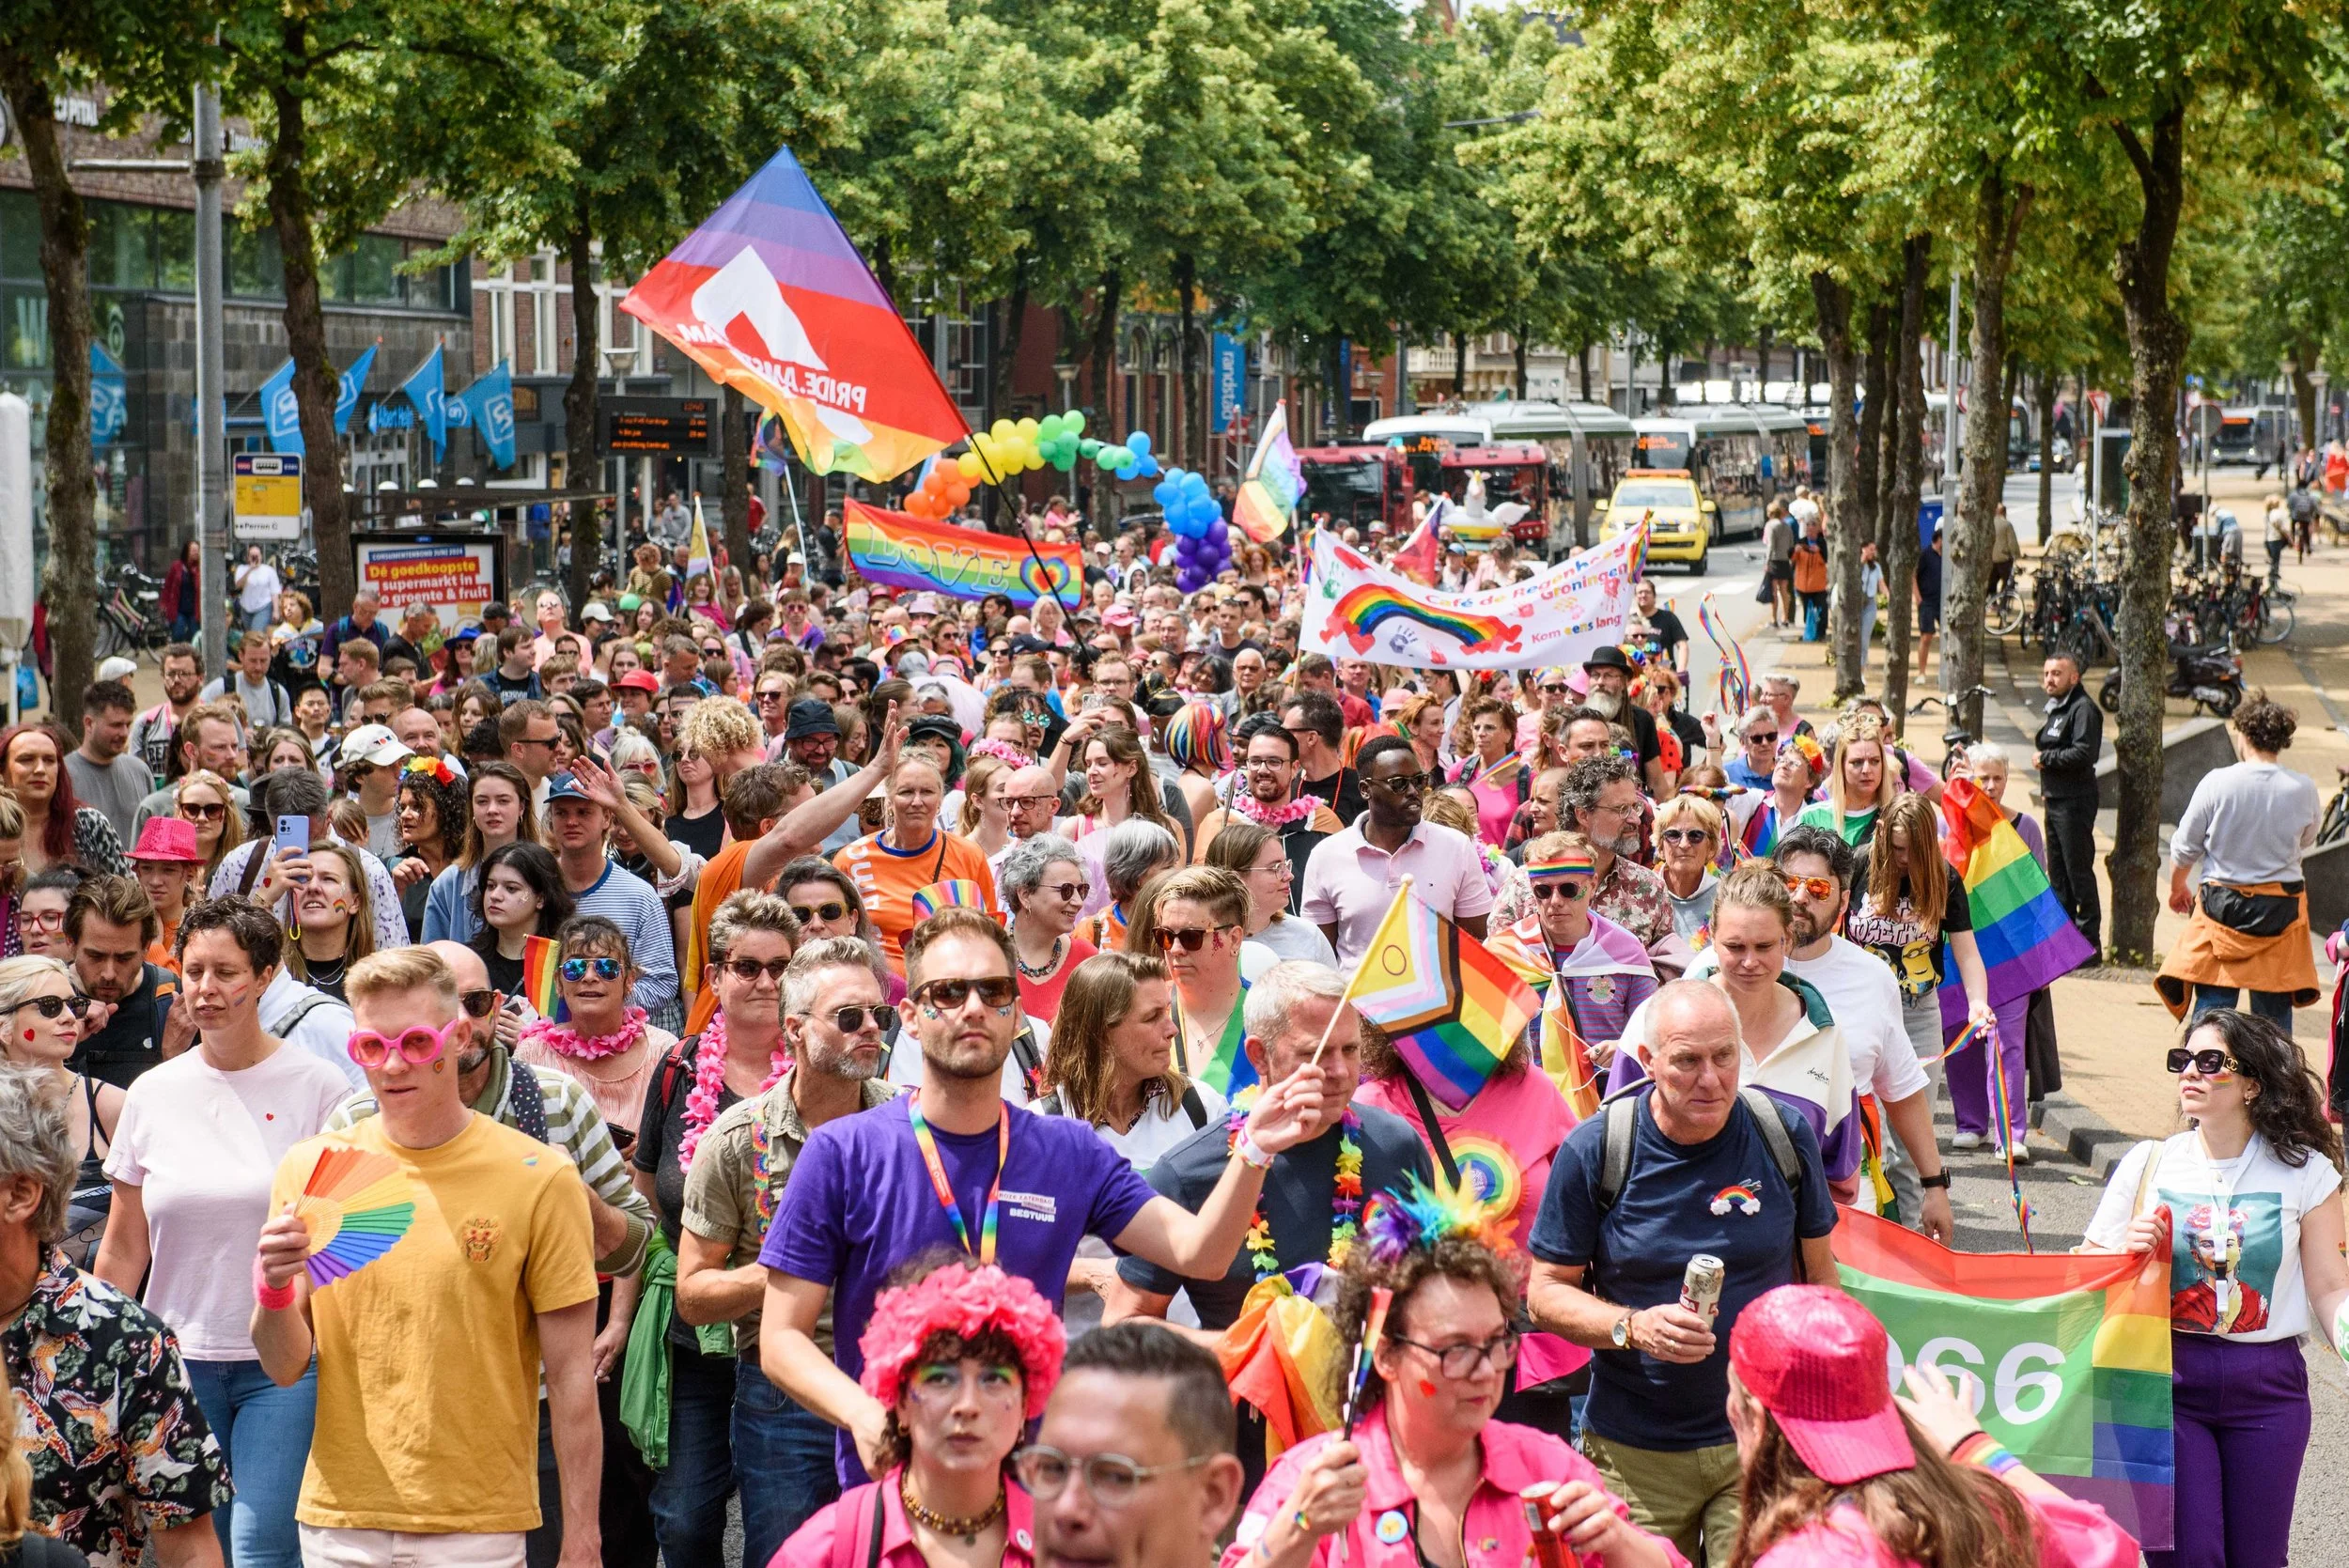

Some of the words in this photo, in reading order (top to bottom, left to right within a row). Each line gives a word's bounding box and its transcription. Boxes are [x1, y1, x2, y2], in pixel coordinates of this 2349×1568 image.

[1221, 350, 1238, 421] randstad
[864, 521, 1011, 595] LOVE
[390, 561, 476, 580] goedkoopste
[382, 575, 458, 593] supermarkt
[460, 574, 473, 585] in
[1541, 563, 1628, 600] Groningen
[392, 591, 443, 607] groente
[446, 589, 457, 600] &
[459, 587, 488, 599] fruit
[1424, 593, 1474, 609] Café
[1480, 592, 1508, 607] de
[1531, 629, 1561, 644] Kom
[1563, 621, 1594, 636] eens
[1009, 1207, 1055, 1223] BESTUUR
[1886, 1331, 2067, 1425] 66
